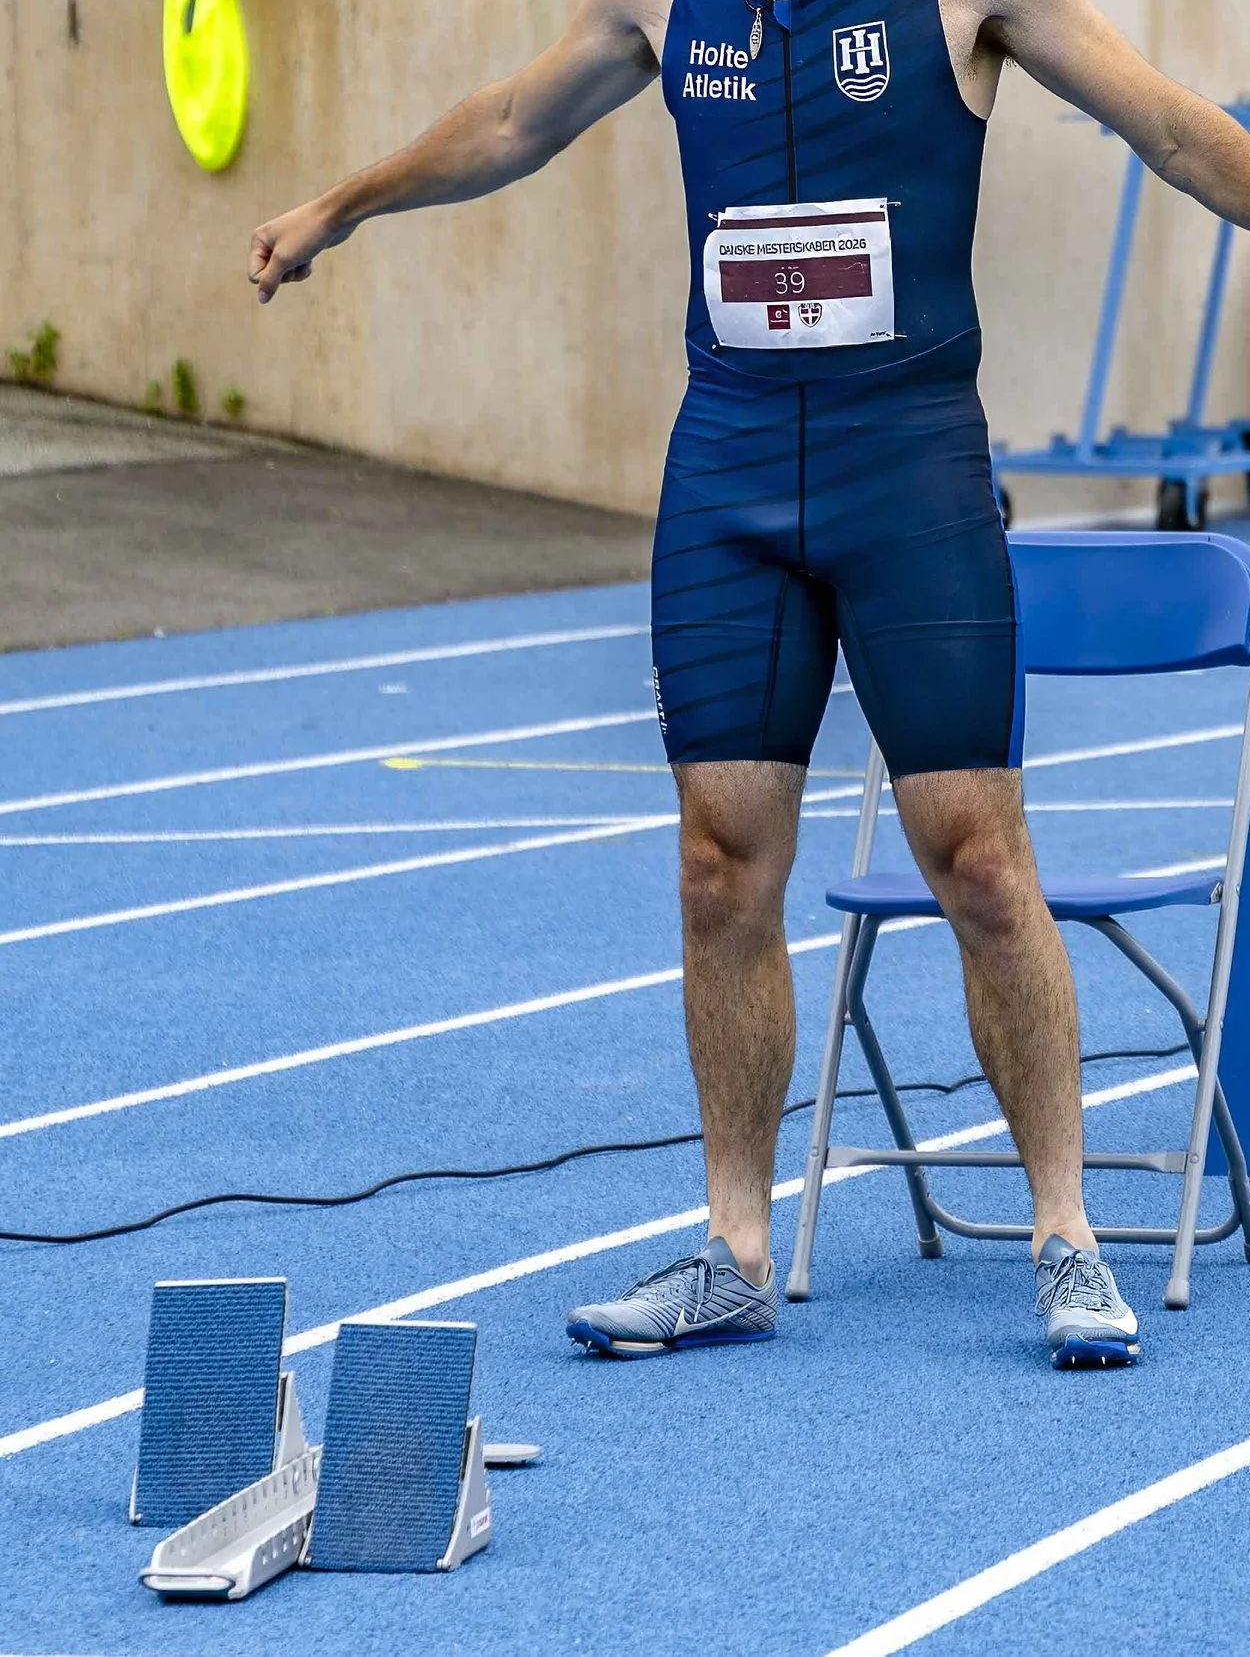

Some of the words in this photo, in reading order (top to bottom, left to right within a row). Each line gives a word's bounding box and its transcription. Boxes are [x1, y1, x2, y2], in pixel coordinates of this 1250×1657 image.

[689, 40, 749, 69] Holte
[682, 72, 757, 101] Atletik
[719, 244, 755, 256] DANSKE
[756, 239, 837, 255] MESTERSKABER
[838, 238, 867, 251] 2026
[774, 271, 805, 295] 39
